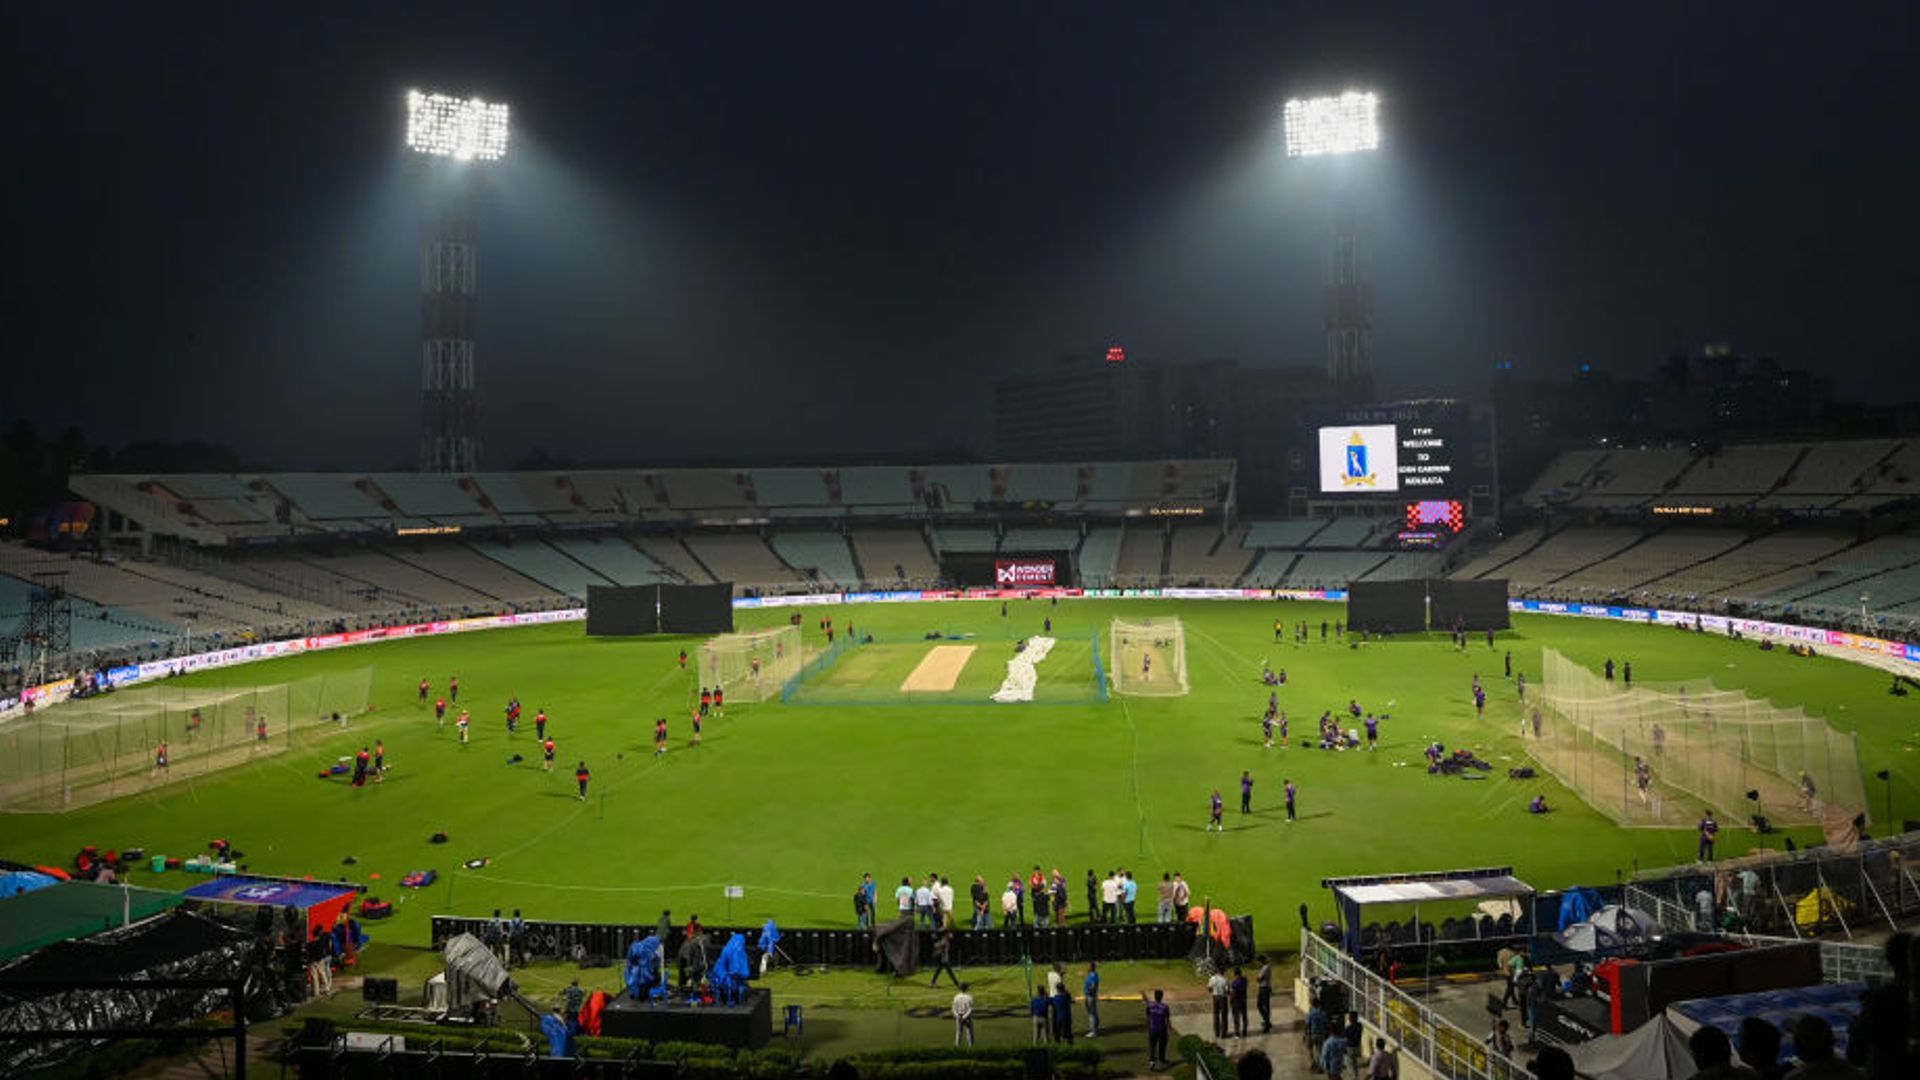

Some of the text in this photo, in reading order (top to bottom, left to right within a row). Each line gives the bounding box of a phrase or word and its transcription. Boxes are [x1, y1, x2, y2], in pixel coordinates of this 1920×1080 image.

[1402, 439, 1443, 448] WELCOME
[1417, 453, 1430, 461] TO
[1016, 564, 1055, 574] WONDER
[1016, 573, 1054, 581] CEMENT
